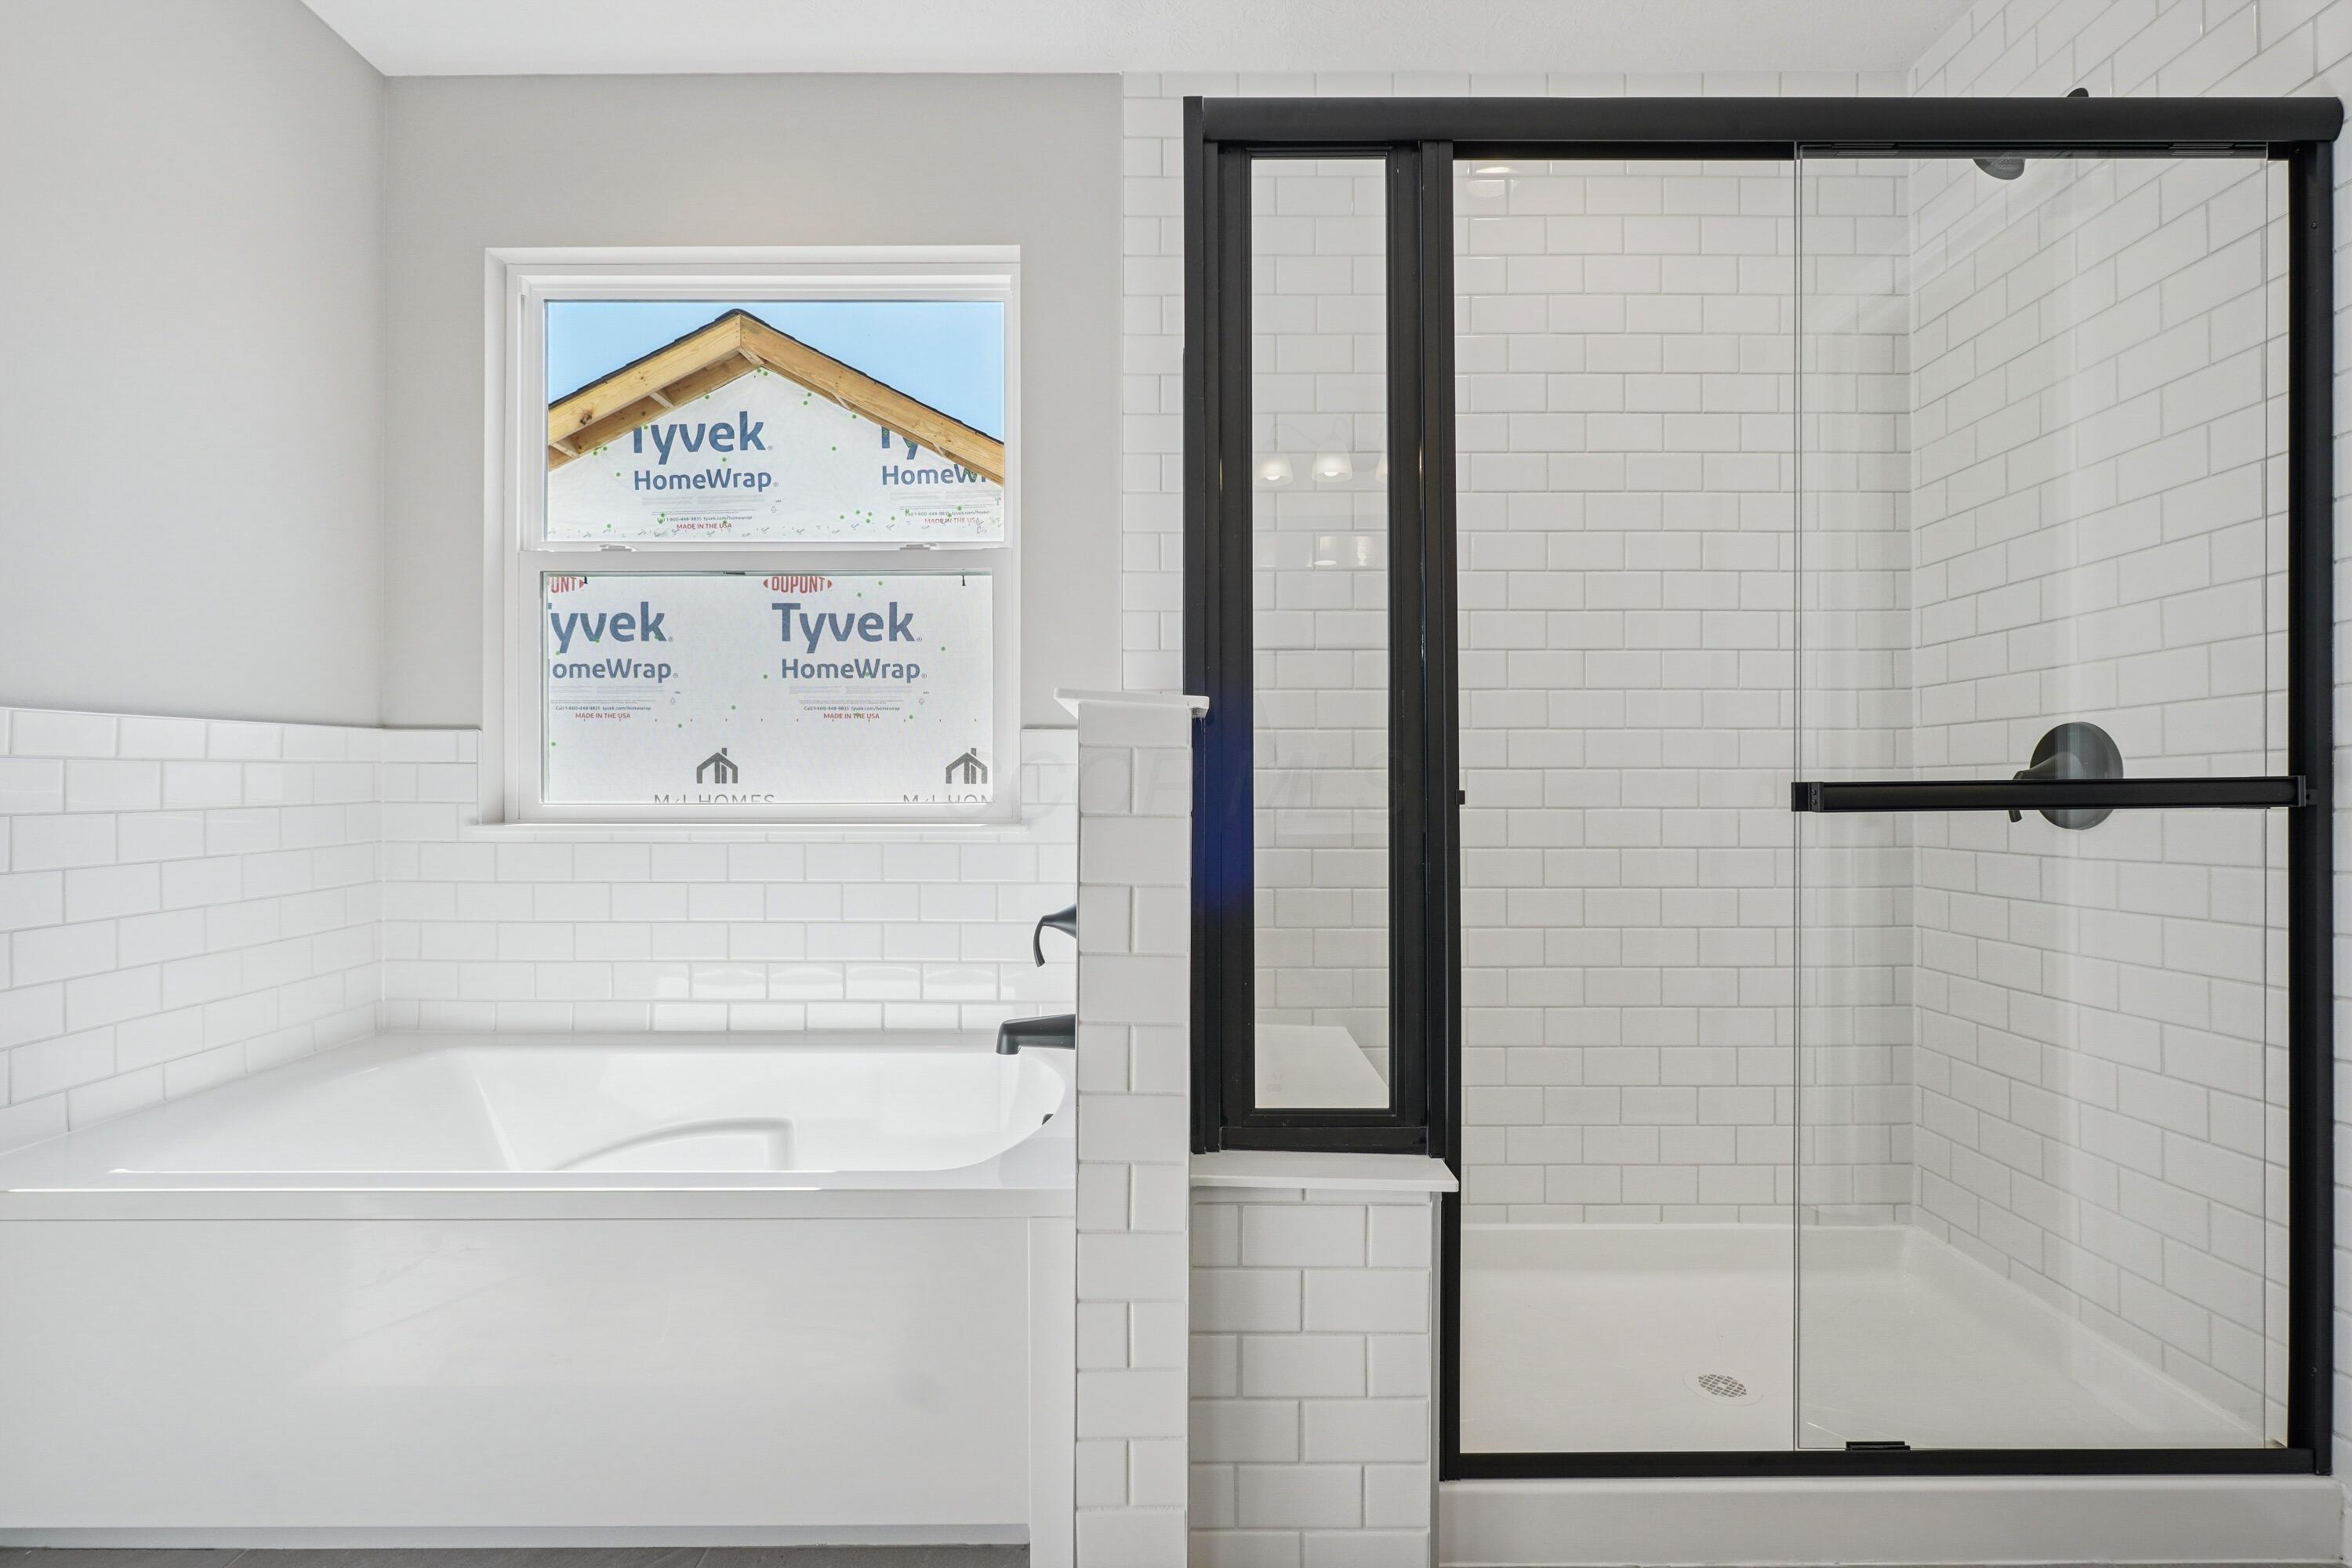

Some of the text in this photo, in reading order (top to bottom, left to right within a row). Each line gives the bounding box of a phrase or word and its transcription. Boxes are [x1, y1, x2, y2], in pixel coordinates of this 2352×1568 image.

[633, 468, 772, 492] HomeWrap
[882, 463, 986, 485] HomeW
[548, 601, 667, 654] yvek
[771, 601, 916, 654] Tyvek
[549, 658, 672, 684] omeWrap
[782, 658, 921, 684] HomeWrap
